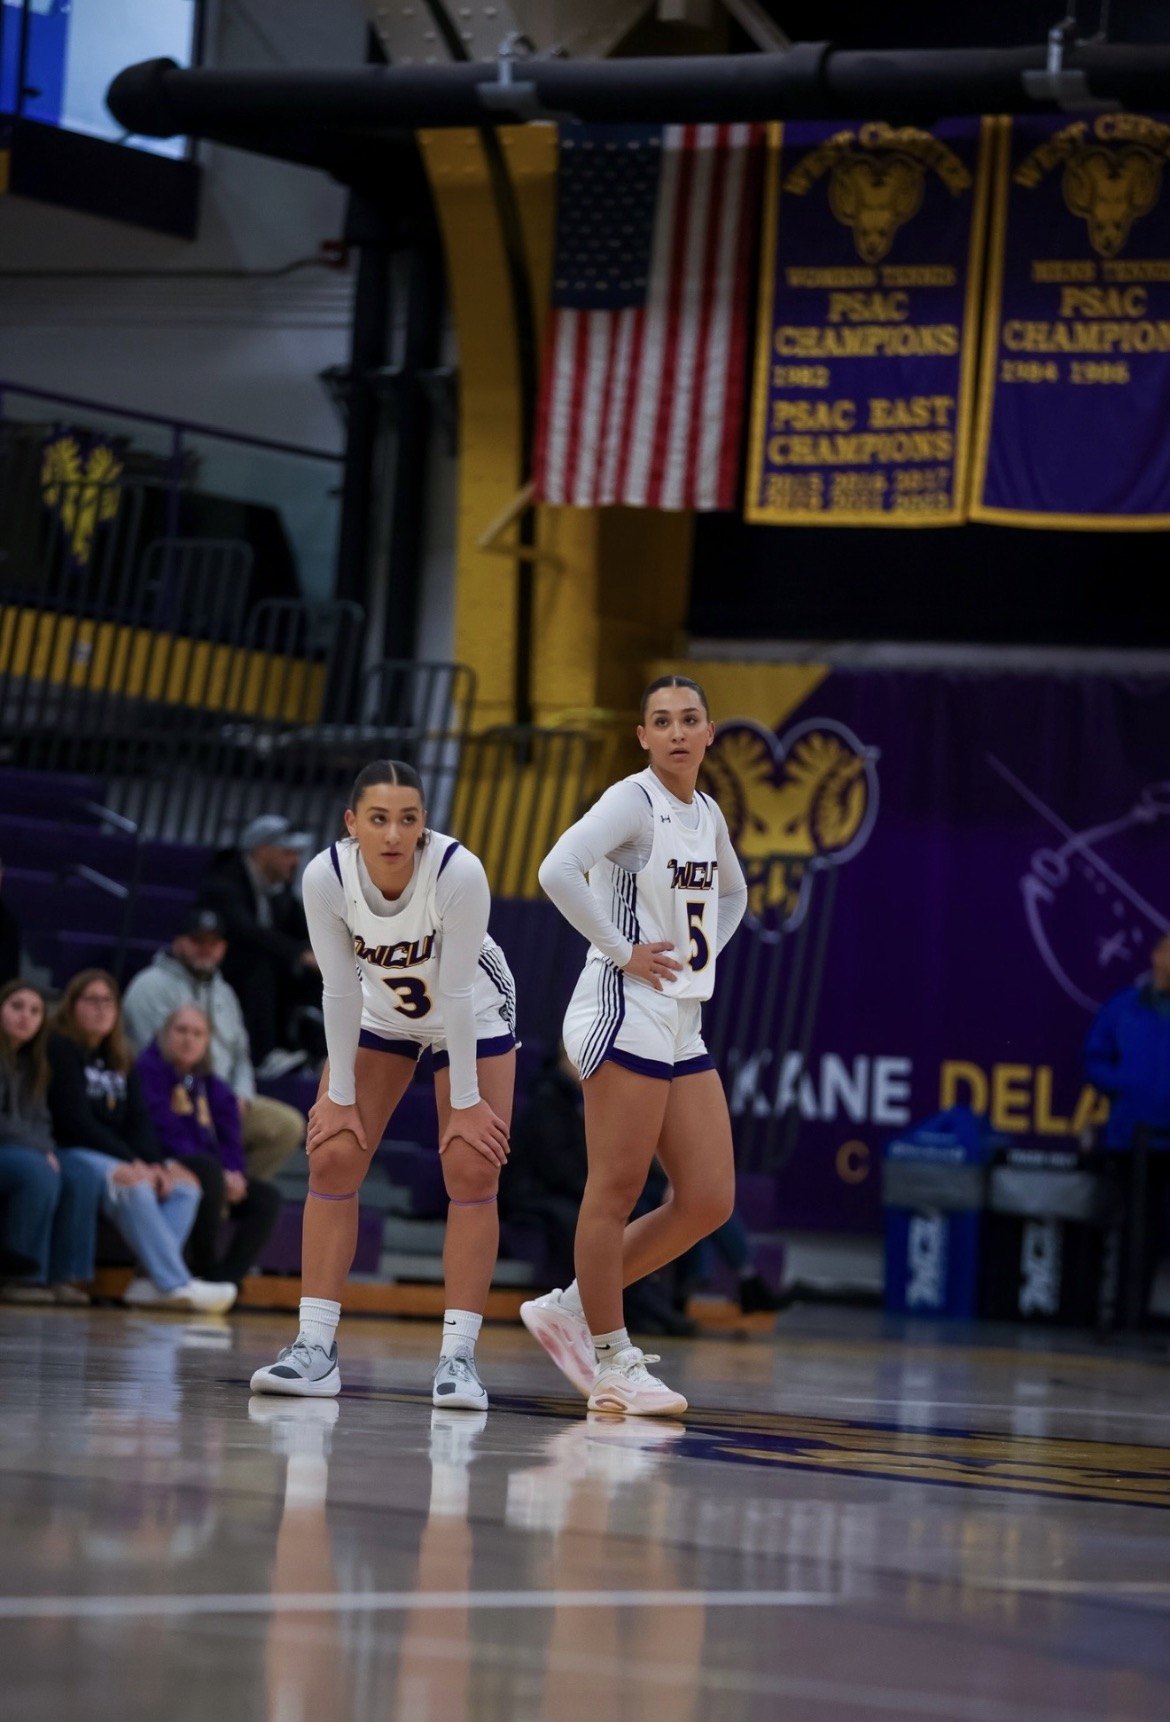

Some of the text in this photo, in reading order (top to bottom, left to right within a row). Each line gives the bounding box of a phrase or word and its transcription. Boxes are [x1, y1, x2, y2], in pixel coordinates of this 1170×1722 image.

[828, 292, 908, 322] PSAC
[1059, 287, 1147, 316] PSAC
[775, 324, 958, 358] CHAMPIONS
[773, 395, 954, 430] PSAC EAST
[768, 430, 953, 465] CHAMPIONS
[354, 929, 436, 969] WCU
[684, 899, 711, 974] 5
[381, 975, 433, 1020] 3
